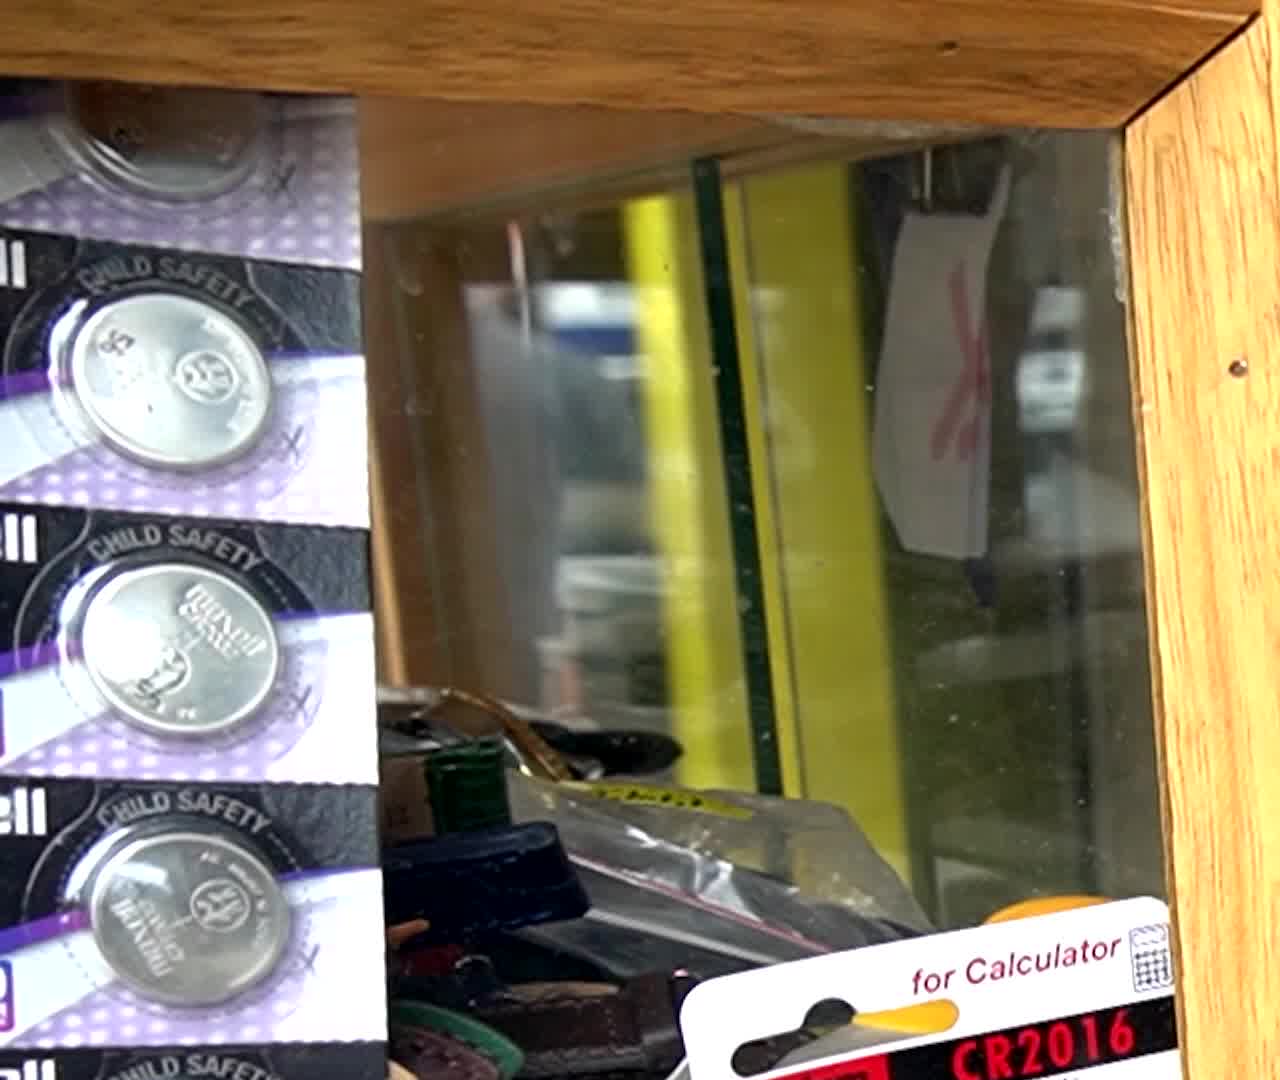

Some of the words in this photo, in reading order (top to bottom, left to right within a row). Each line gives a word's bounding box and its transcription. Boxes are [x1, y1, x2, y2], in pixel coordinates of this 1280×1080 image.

[79, 254, 152, 296] CHILD
[159, 255, 254, 308] SAFETY
[87, 525, 162, 561] CHILD
[168, 523, 263, 574] SAFETY
[98, 790, 171, 828] CHILD
[178, 788, 269, 835] SAFETY
[911, 968, 956, 996] for
[966, 935, 1123, 986] Calculator
